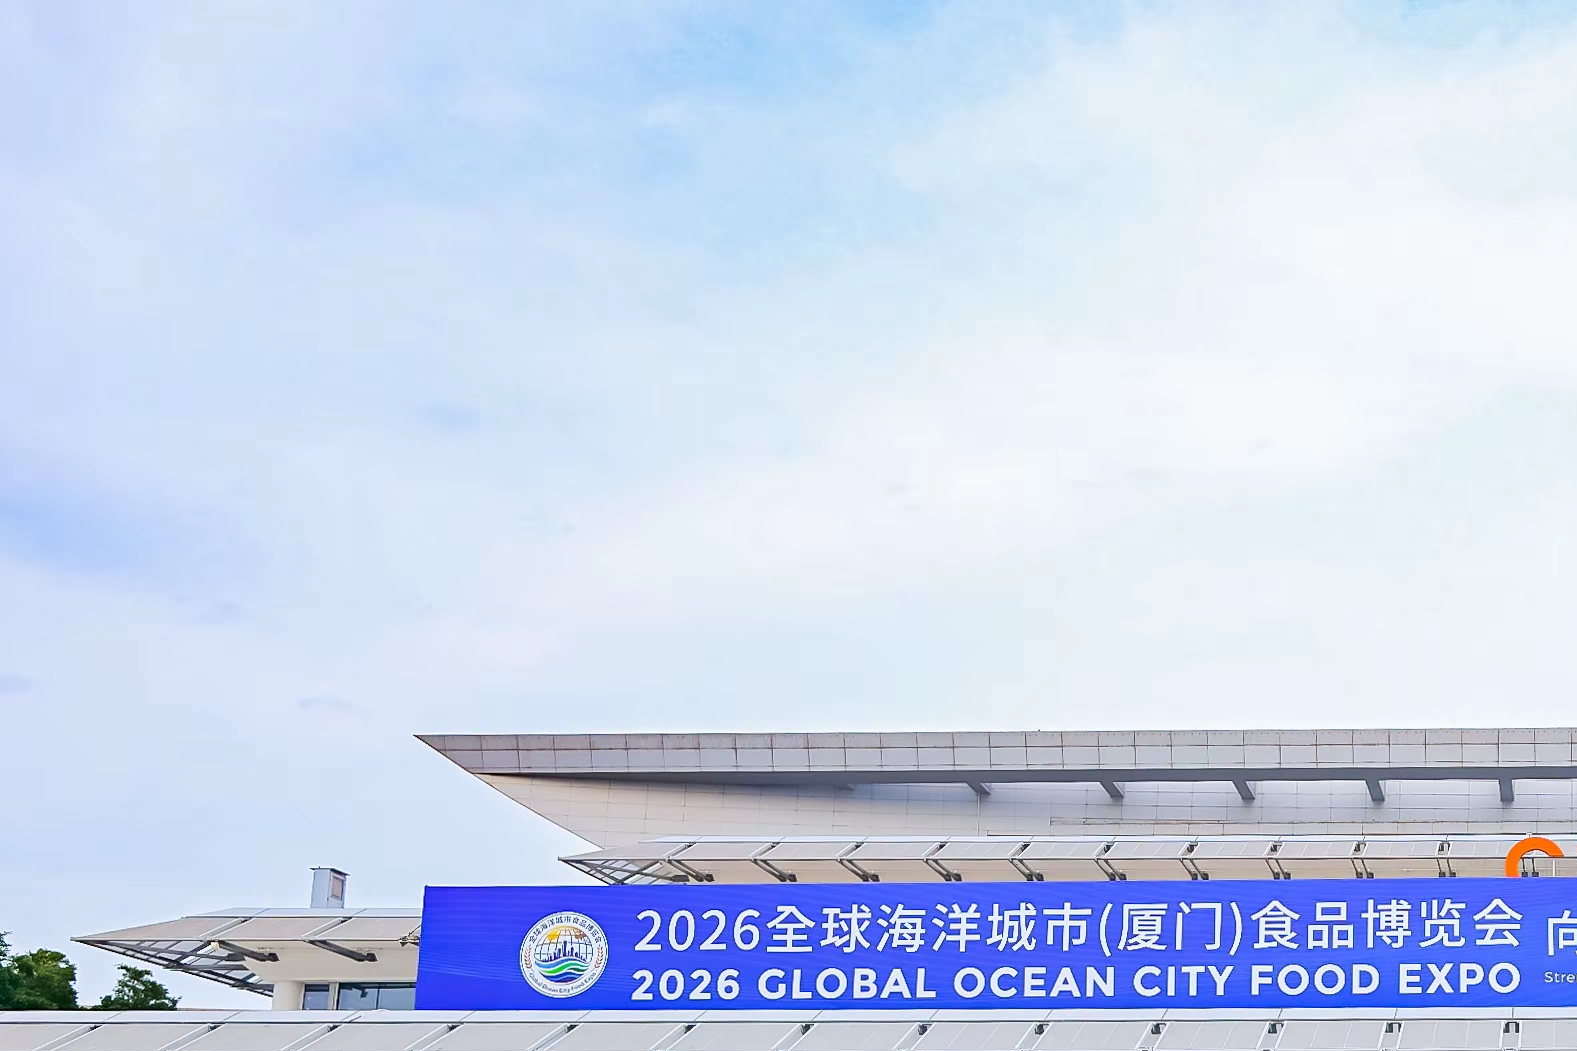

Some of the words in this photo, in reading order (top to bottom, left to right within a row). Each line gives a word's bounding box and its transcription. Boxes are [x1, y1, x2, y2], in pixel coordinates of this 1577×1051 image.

[635, 899, 1522, 957] 2026全球海洋城市(厦门)食品博览会
[632, 969, 740, 1000] 2026
[759, 968, 935, 999] GLOBAL
[954, 967, 1114, 997] OCEAN
[1134, 966, 1234, 996] CITY
[1252, 964, 1379, 995] FOOD
[1399, 963, 1521, 993] EXPO
